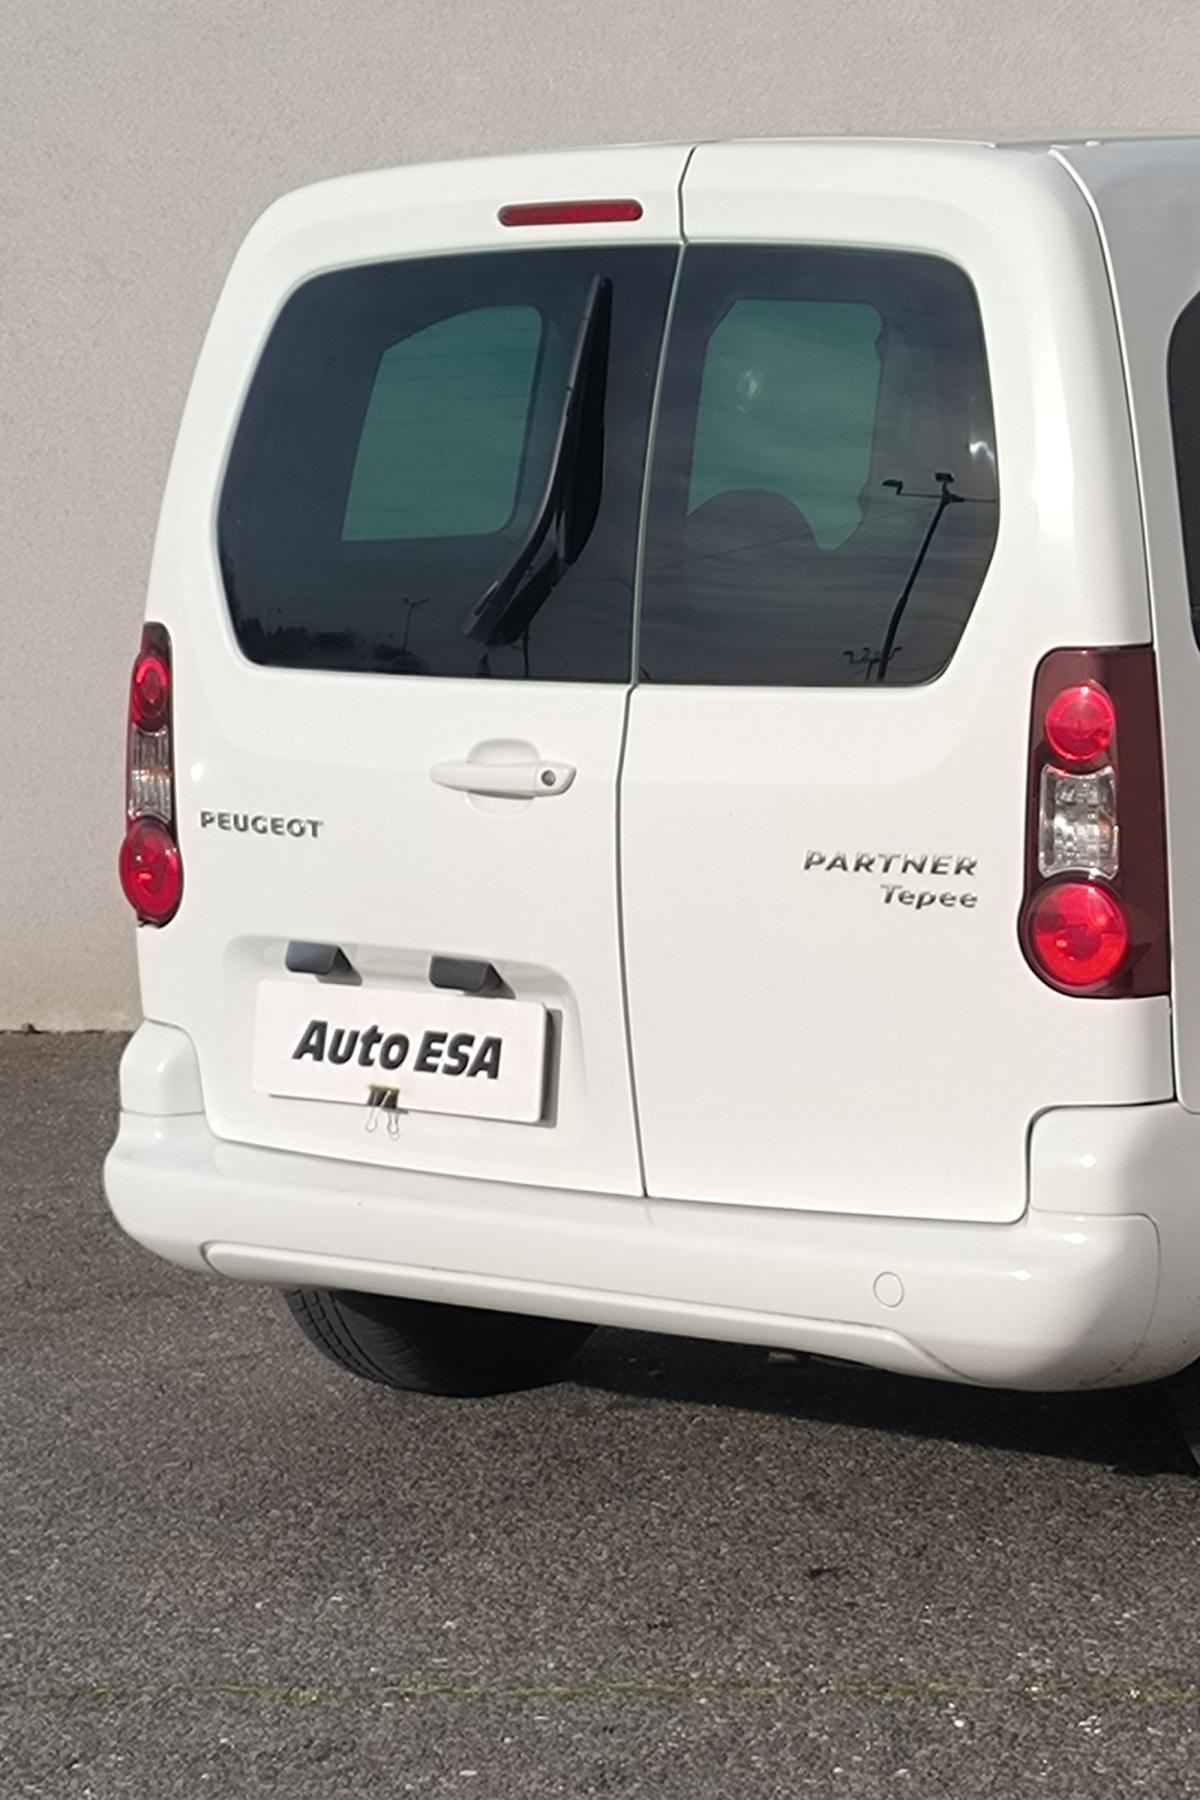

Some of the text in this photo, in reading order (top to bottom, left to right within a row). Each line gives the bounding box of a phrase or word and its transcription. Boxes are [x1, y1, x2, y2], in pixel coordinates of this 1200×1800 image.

[200, 810, 324, 838] PEUGEOT
[803, 850, 977, 876] PARTNER
[880, 884, 978, 910] Tepee
[292, 1019, 503, 1080] Auto ESA
